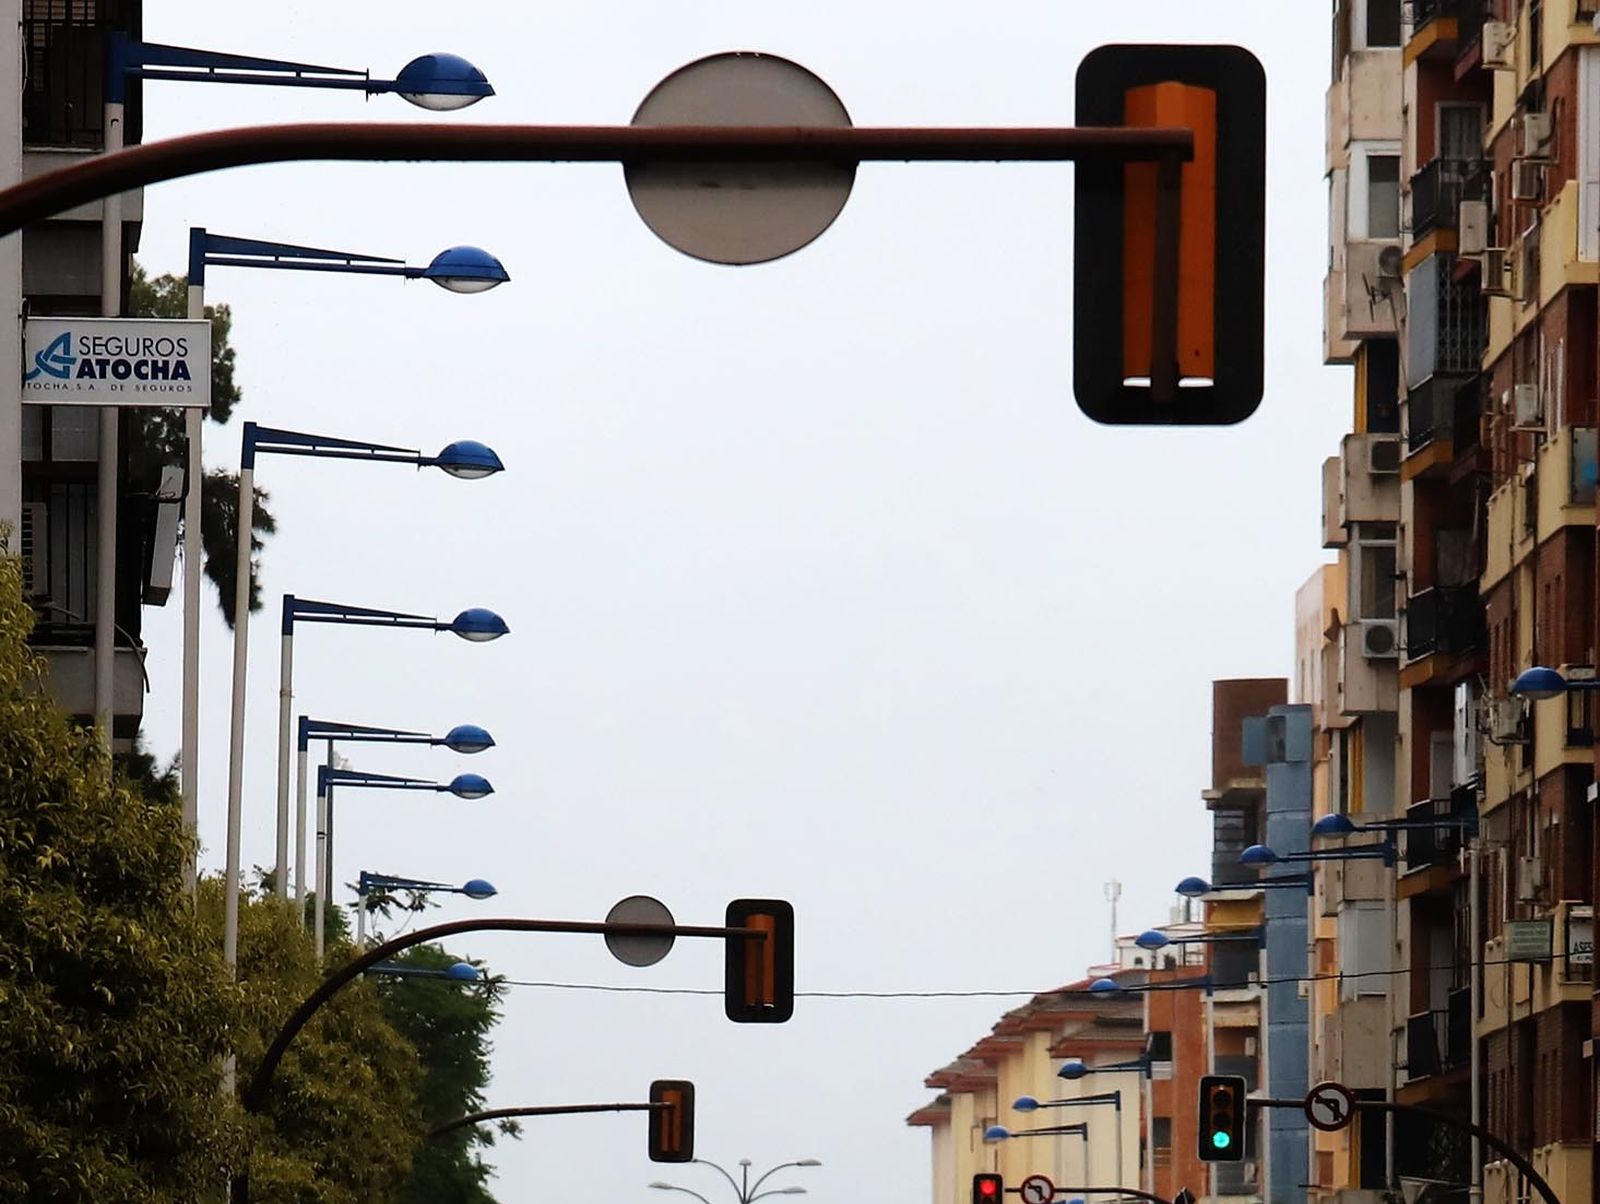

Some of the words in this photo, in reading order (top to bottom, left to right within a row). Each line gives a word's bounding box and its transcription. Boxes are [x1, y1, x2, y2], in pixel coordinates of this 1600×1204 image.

[79, 336, 188, 358] SEGUROS
[76, 358, 191, 381] ATOCHA
[110, 384, 125, 392] DE
[135, 384, 193, 393] SEGUROS
